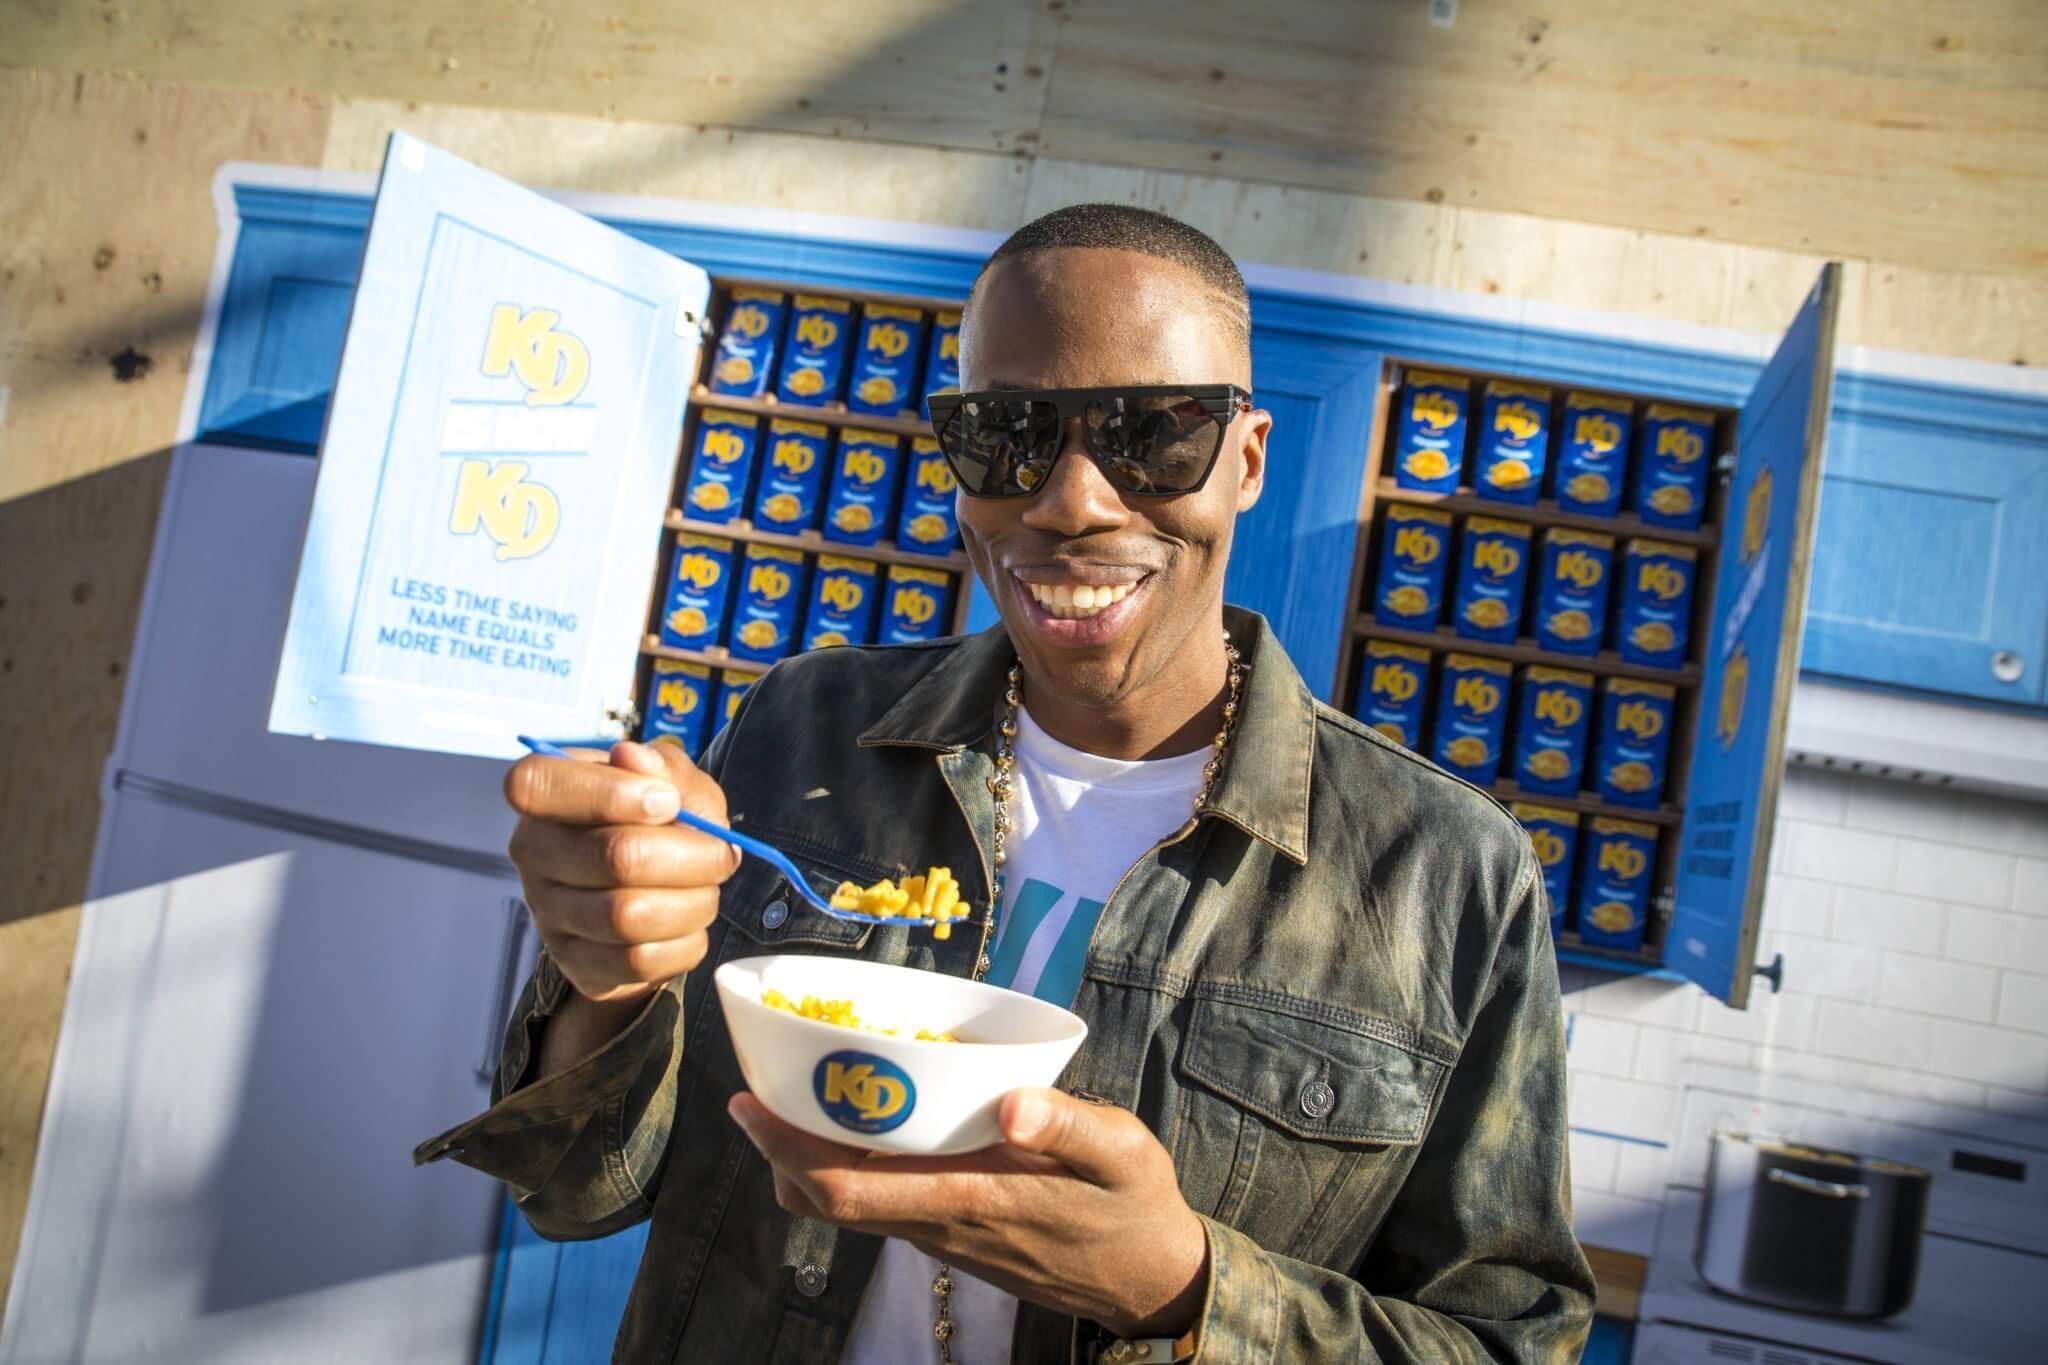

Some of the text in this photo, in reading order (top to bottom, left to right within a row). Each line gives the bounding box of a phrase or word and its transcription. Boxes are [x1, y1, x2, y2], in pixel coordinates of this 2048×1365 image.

[797, 315, 837, 347] KD
[866, 323, 909, 358] KD
[939, 334, 960, 360] K
[481, 302, 591, 407] KD
[703, 430, 744, 462] KD
[774, 440, 814, 473] KD
[1657, 427, 1701, 462] KD
[844, 450, 885, 483] KD
[449, 459, 561, 562] KD
[1394, 527, 1439, 564] KD
[1473, 540, 1518, 575] KD
[679, 553, 720, 588] KD
[749, 565, 790, 599] KD
[1556, 552, 1602, 587] KD
[1639, 564, 1684, 598] KD
[391, 576, 578, 632] LESS TIME SAYING
[821, 577, 862, 611] KD
[893, 588, 935, 623] KD
[408, 605, 556, 650] NAME EQUALS
[377, 625, 572, 677] MORE TIME EATING
[657, 680, 698, 714] KD
[1371, 664, 1418, 701] KD
[1454, 677, 1499, 714] KD
[1535, 691, 1581, 726] KD
[1618, 703, 1662, 739] KD
[1599, 842, 1644, 878] KD
[825, 1061, 907, 1119] KD
